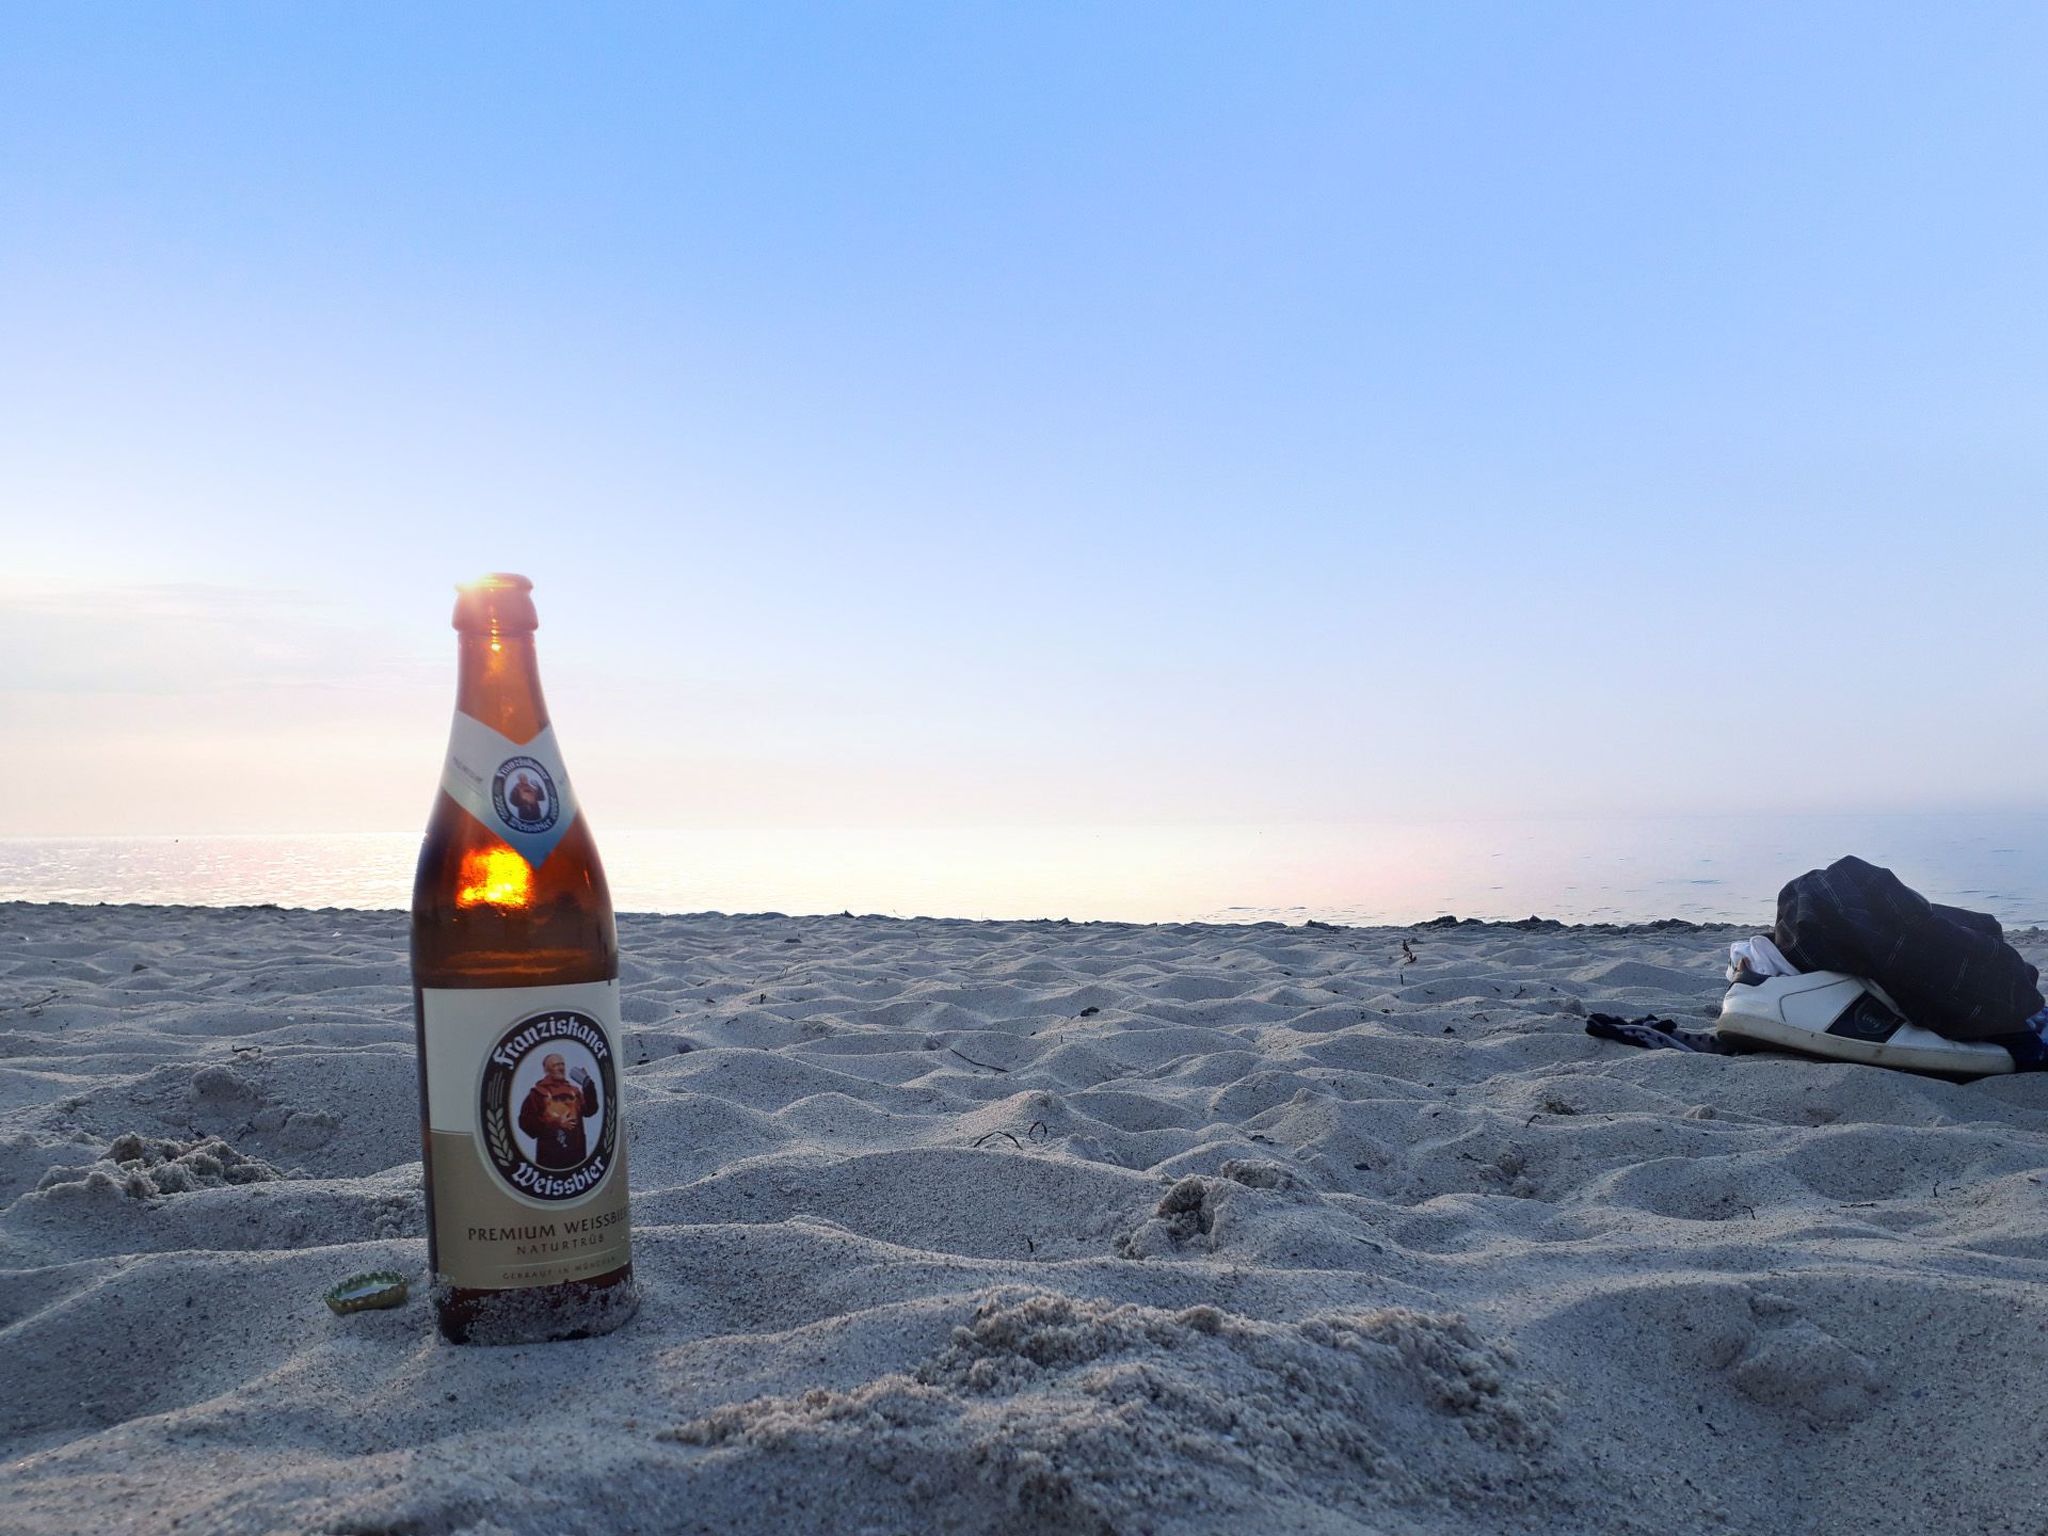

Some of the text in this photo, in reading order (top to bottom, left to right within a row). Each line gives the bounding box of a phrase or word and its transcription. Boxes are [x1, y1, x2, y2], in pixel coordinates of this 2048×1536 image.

[493, 1016, 608, 1070] Franziskaner
[512, 1156, 605, 1196] Weissbier
[468, 1224, 556, 1241] PREMIUM
